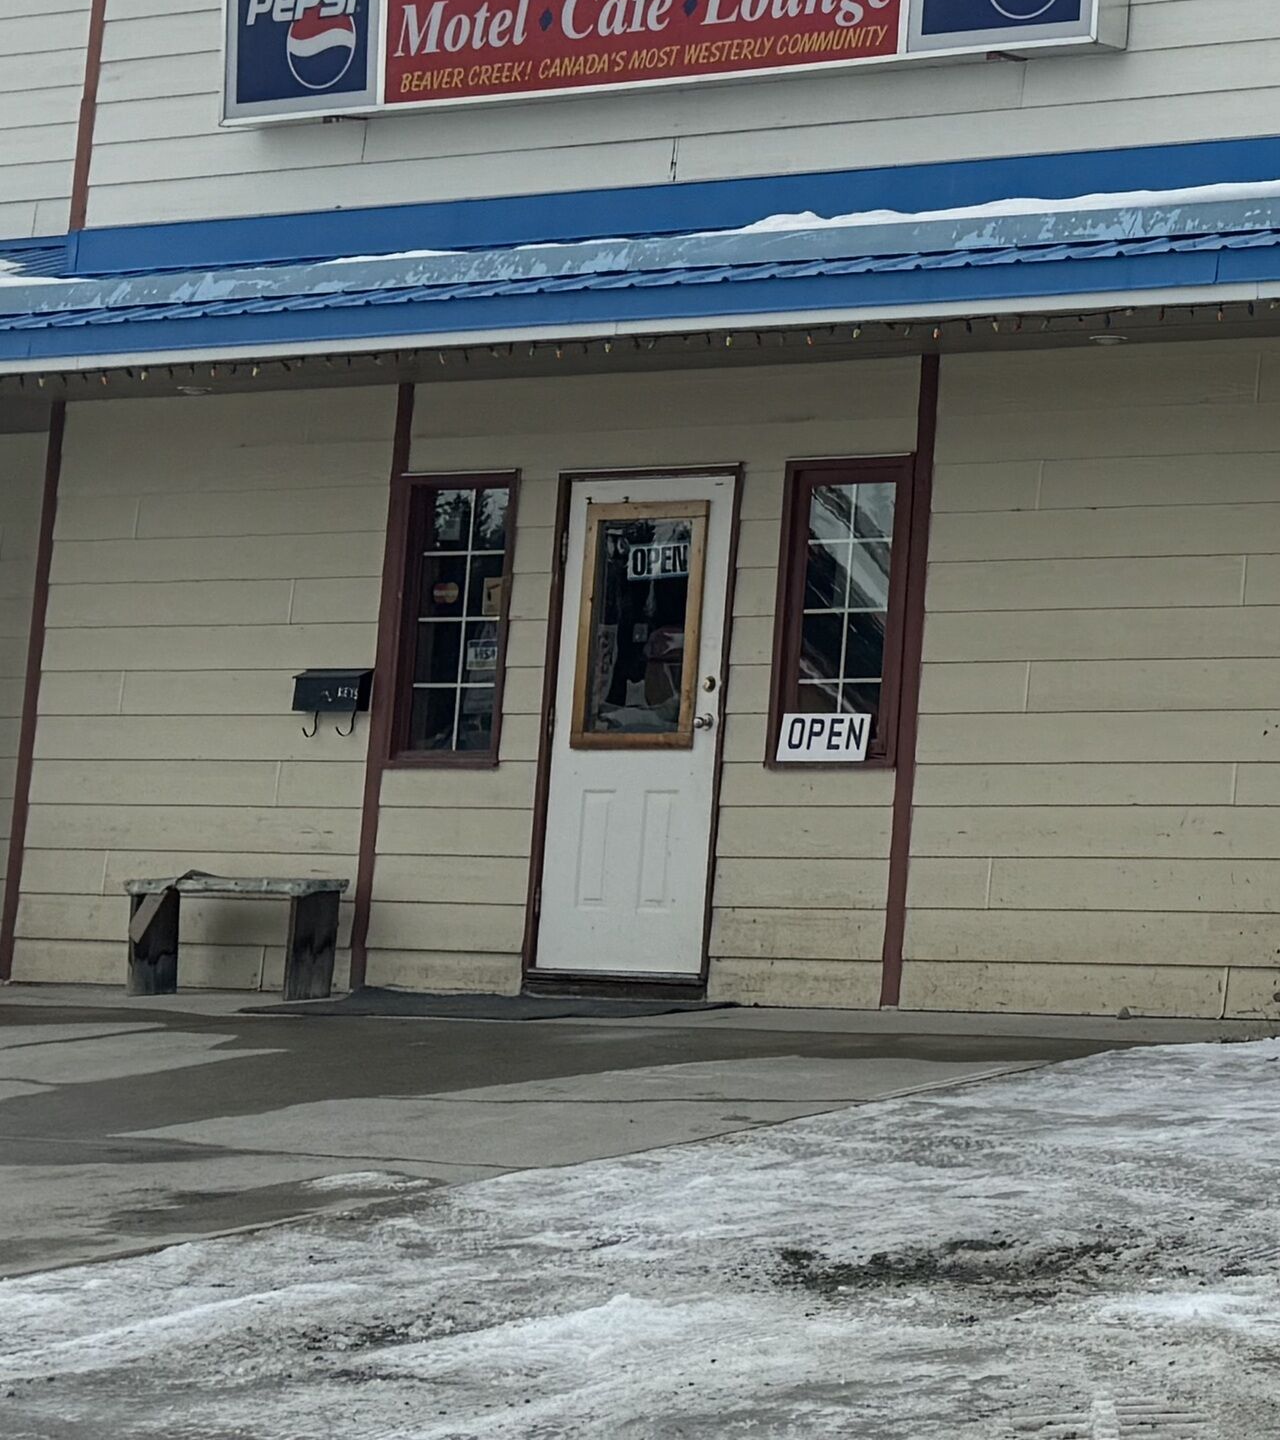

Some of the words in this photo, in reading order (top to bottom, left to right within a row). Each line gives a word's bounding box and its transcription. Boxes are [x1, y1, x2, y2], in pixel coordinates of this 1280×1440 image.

[400, 68, 465, 93] BEAVER
[468, 61, 532, 87] CREEK!
[538, 50, 627, 79] CANADA'S
[628, 45, 681, 70] MOST
[684, 35, 775, 66] WESTERLY
[776, 25, 888, 56] COMMUNITY
[632, 544, 690, 576] OPEN
[787, 717, 865, 750] OPEN
